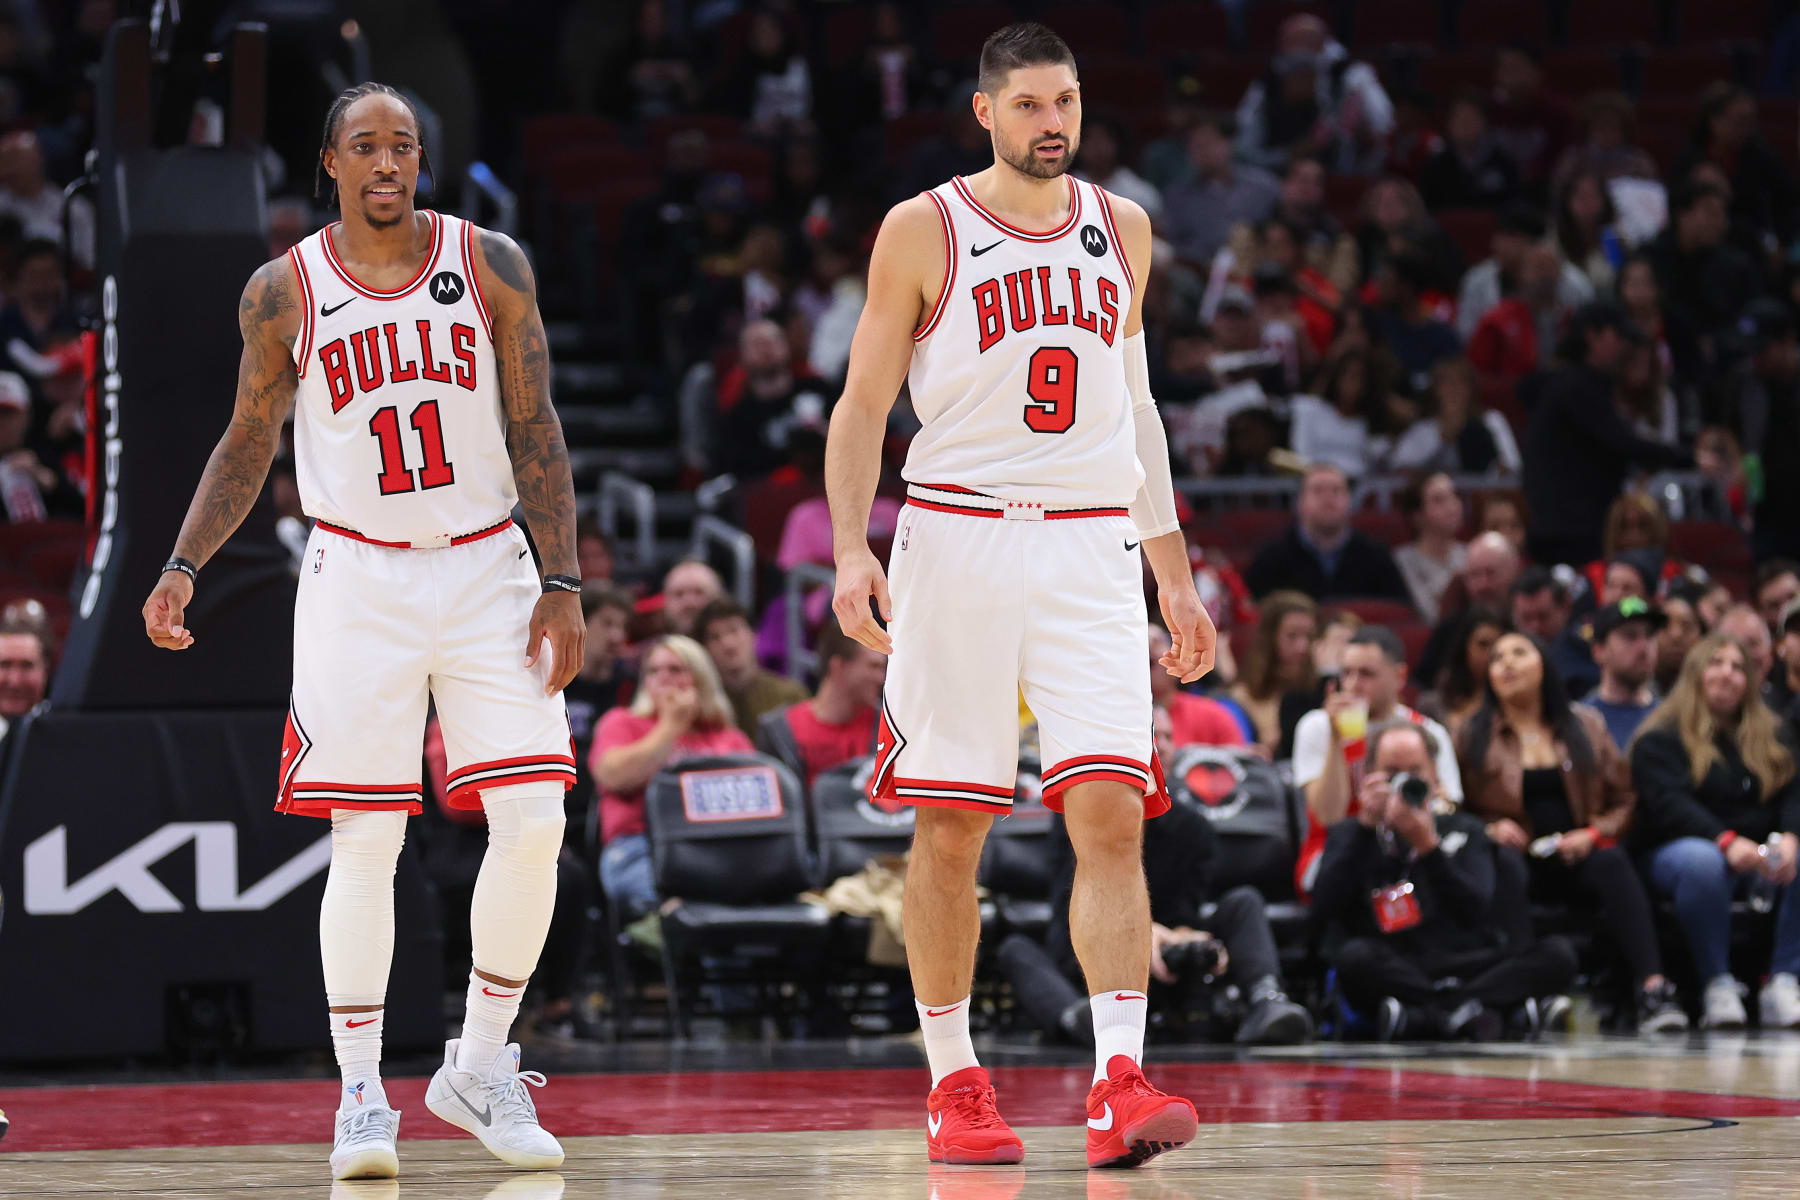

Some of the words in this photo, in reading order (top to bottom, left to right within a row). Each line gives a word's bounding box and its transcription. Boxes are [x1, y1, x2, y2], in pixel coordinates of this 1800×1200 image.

[972, 266, 1118, 354] BULLS
[318, 319, 477, 415] BULLS
[1023, 346, 1079, 434] 9
[79, 274, 122, 620] coinbase
[369, 399, 455, 496] 11
